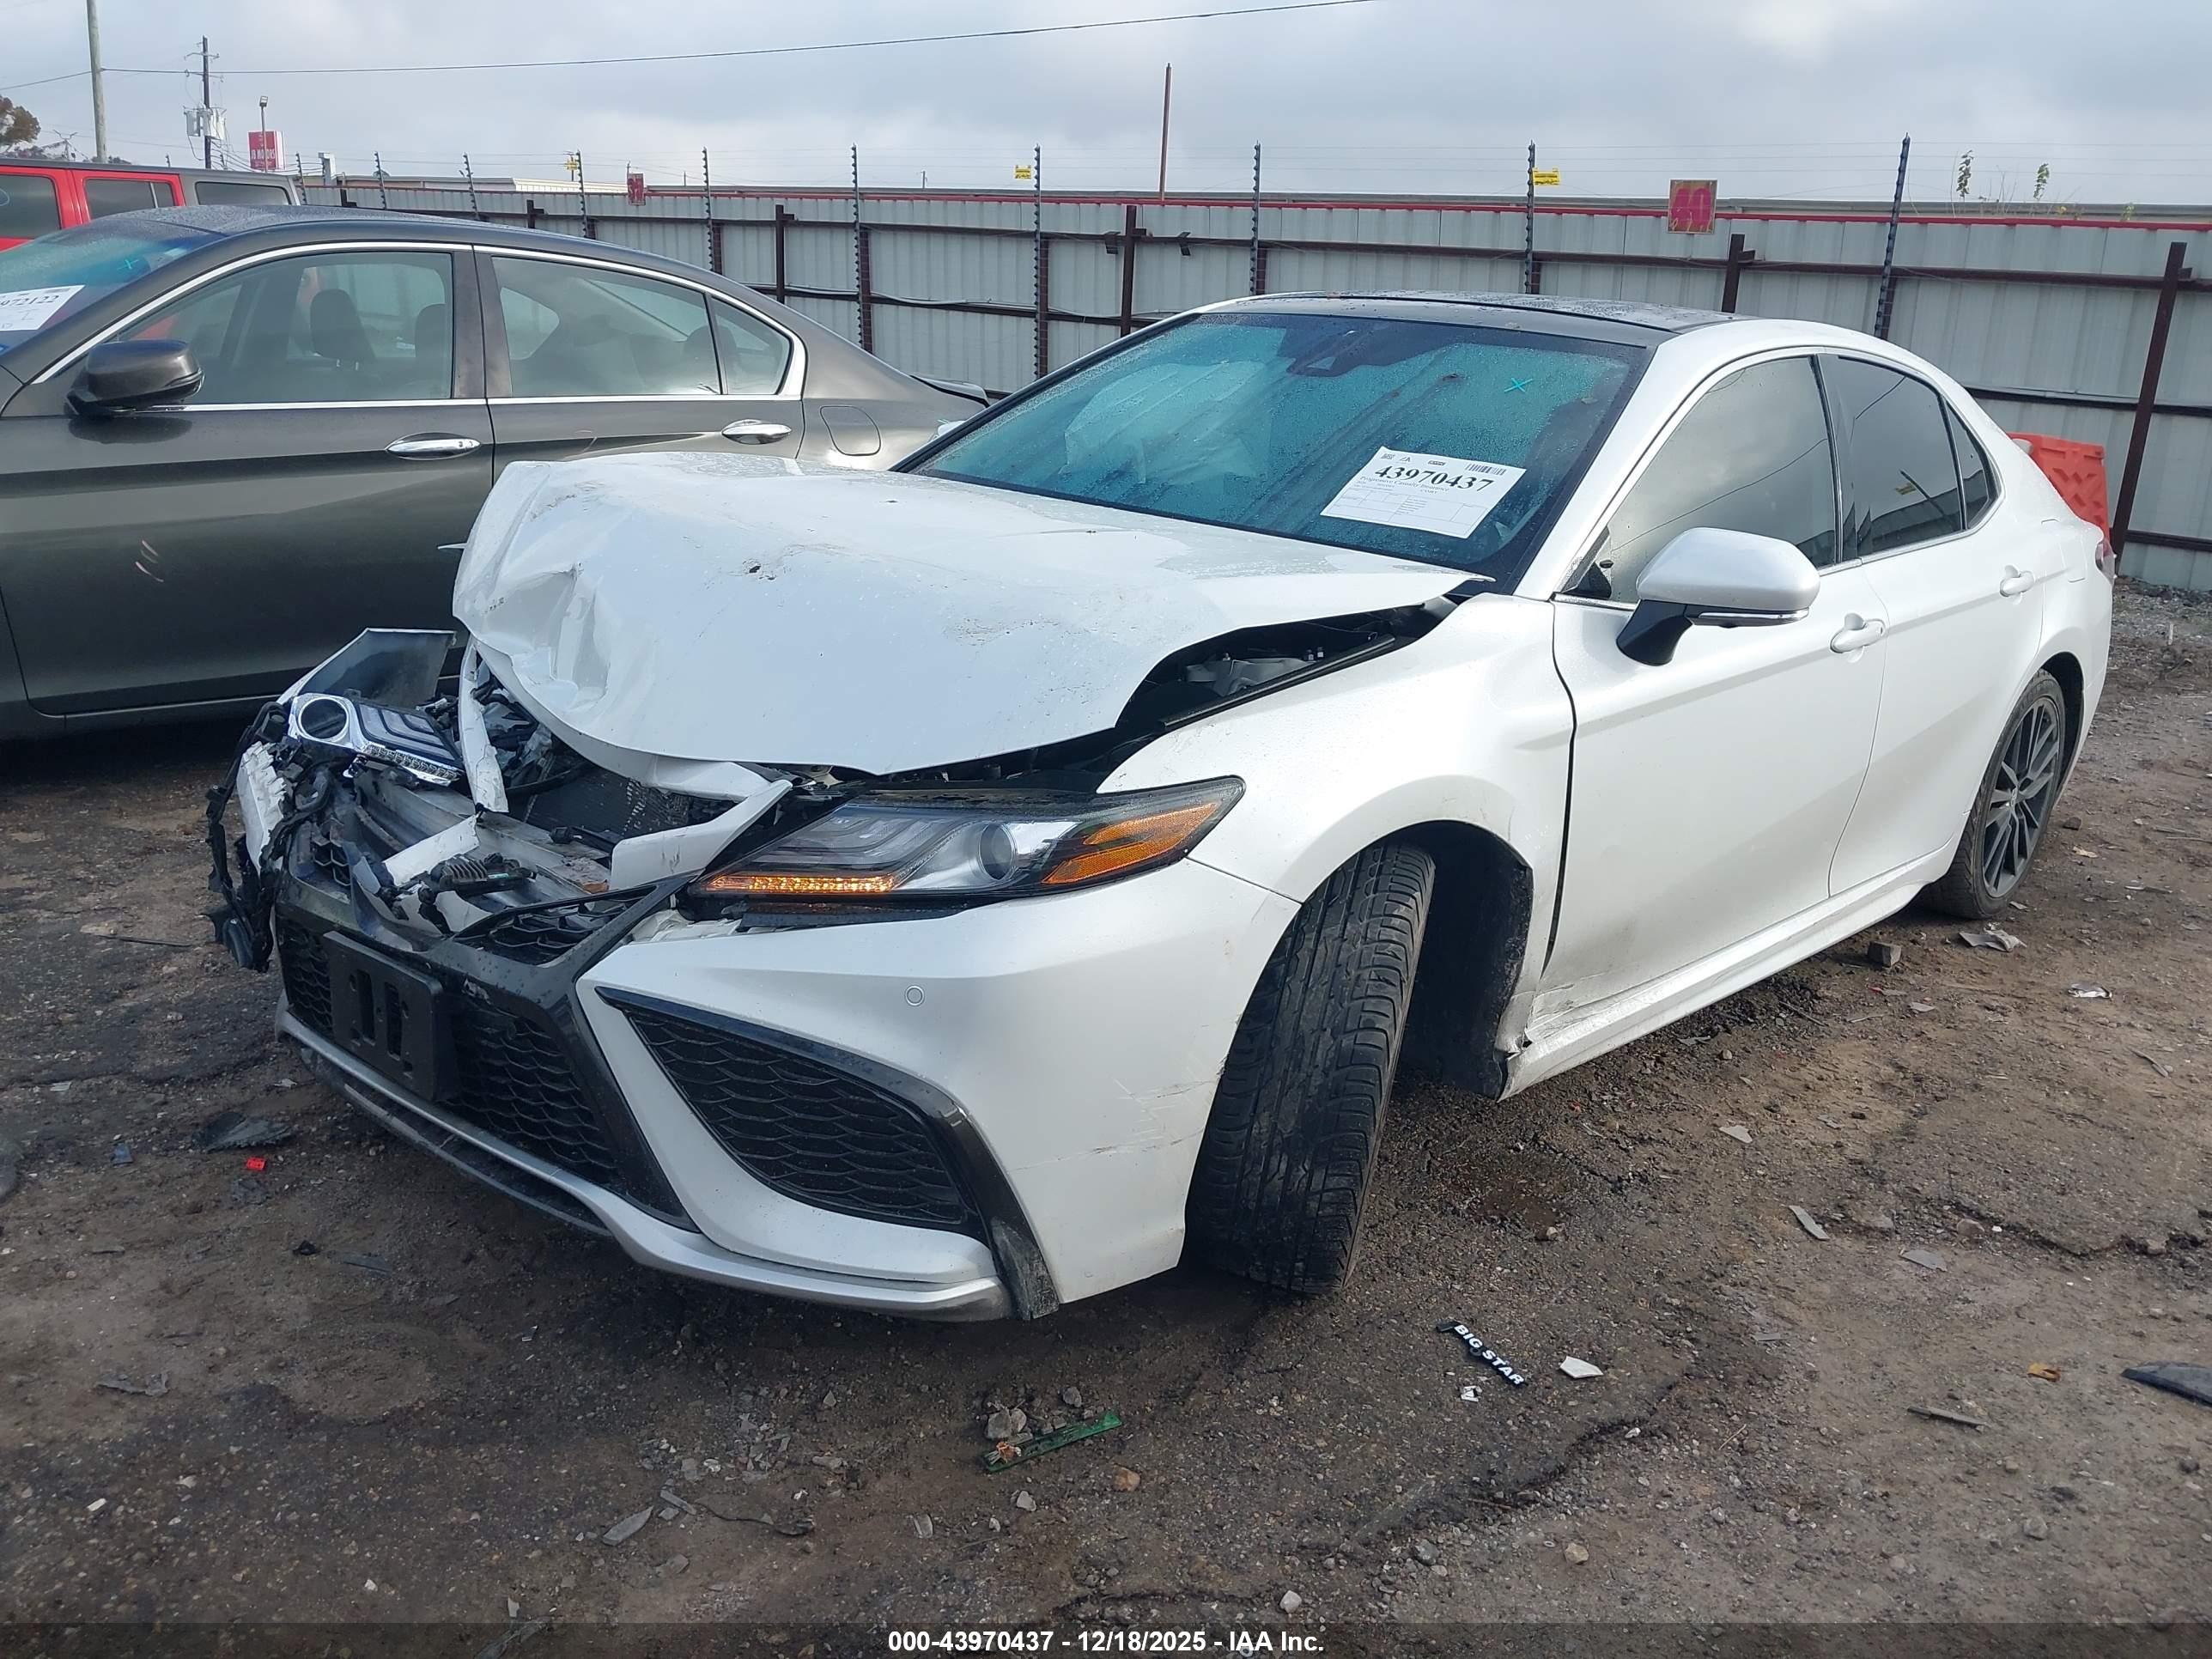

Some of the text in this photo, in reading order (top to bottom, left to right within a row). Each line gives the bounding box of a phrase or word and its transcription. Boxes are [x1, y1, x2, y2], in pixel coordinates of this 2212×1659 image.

[257, 149, 276, 160] MOORS
[0, 295, 59, 307] 972122
[1375, 465, 1494, 492] 43970437
[1454, 1324, 1525, 1385] BIG STAR
